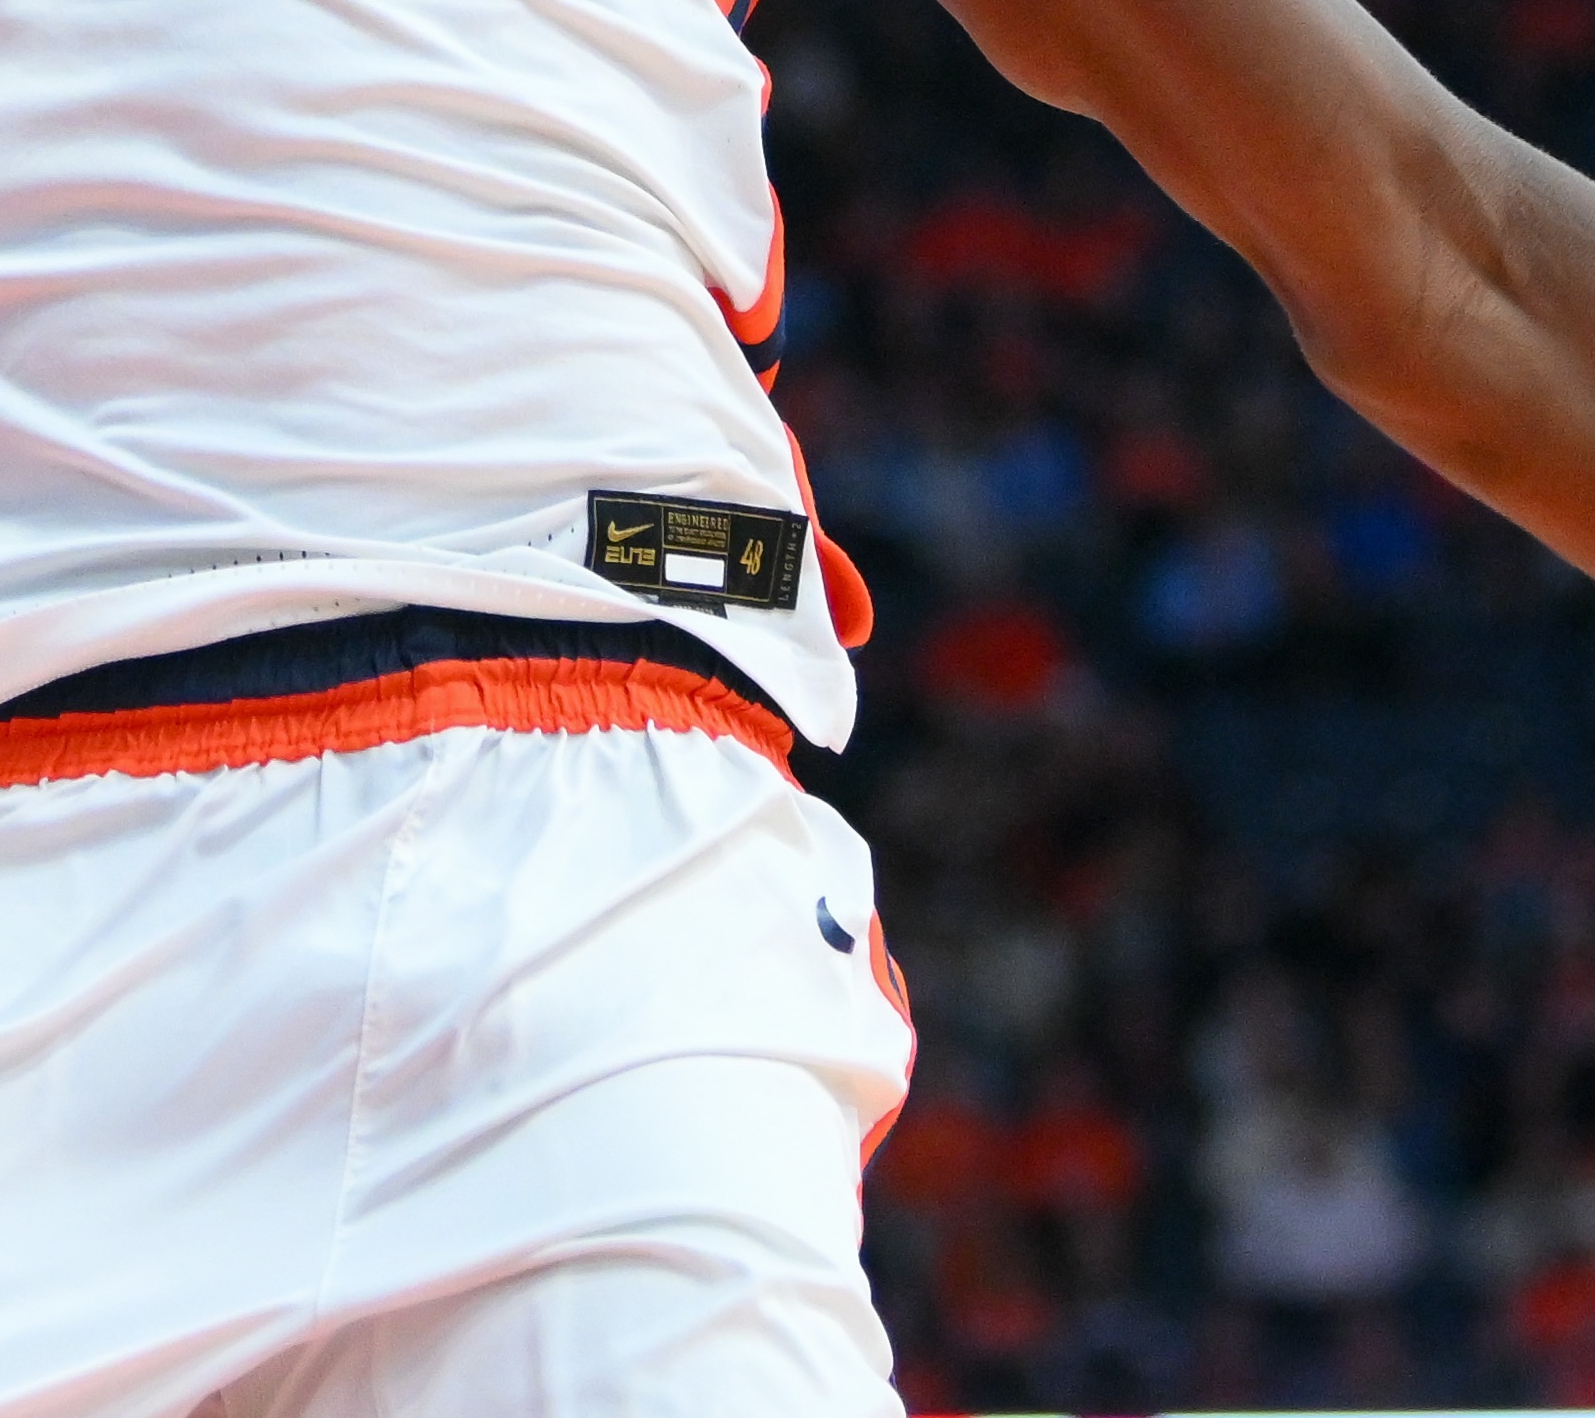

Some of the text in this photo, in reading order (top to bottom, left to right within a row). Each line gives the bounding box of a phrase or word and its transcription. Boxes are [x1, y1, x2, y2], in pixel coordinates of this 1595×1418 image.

[668, 512, 729, 531] ENGINEERED
[605, 546, 656, 566] ELITE
[740, 538, 764, 575] 48
[778, 543, 797, 601] LENGTH
